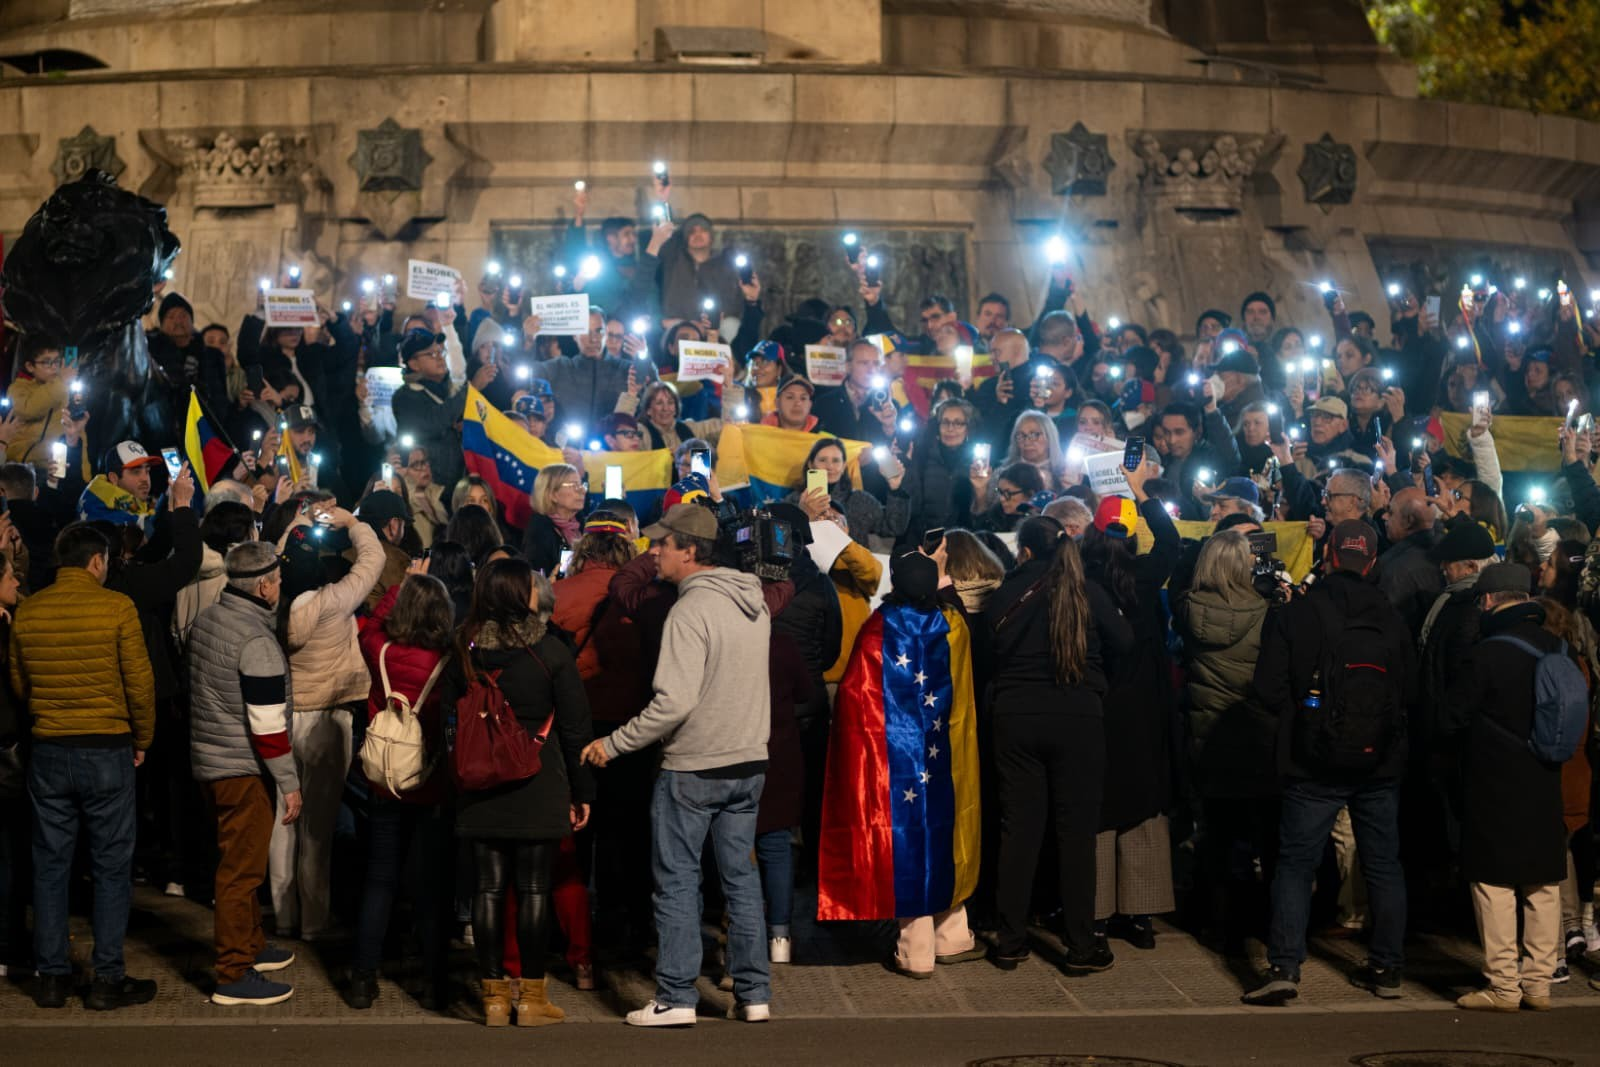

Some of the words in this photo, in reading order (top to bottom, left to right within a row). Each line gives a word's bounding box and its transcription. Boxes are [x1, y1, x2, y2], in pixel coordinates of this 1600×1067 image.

[412, 266, 423, 274] EL
[426, 267, 456, 279] NOBEL
[268, 295, 277, 303] EL
[278, 296, 300, 304] NOBEL
[694, 349, 717, 357] NOBEL
